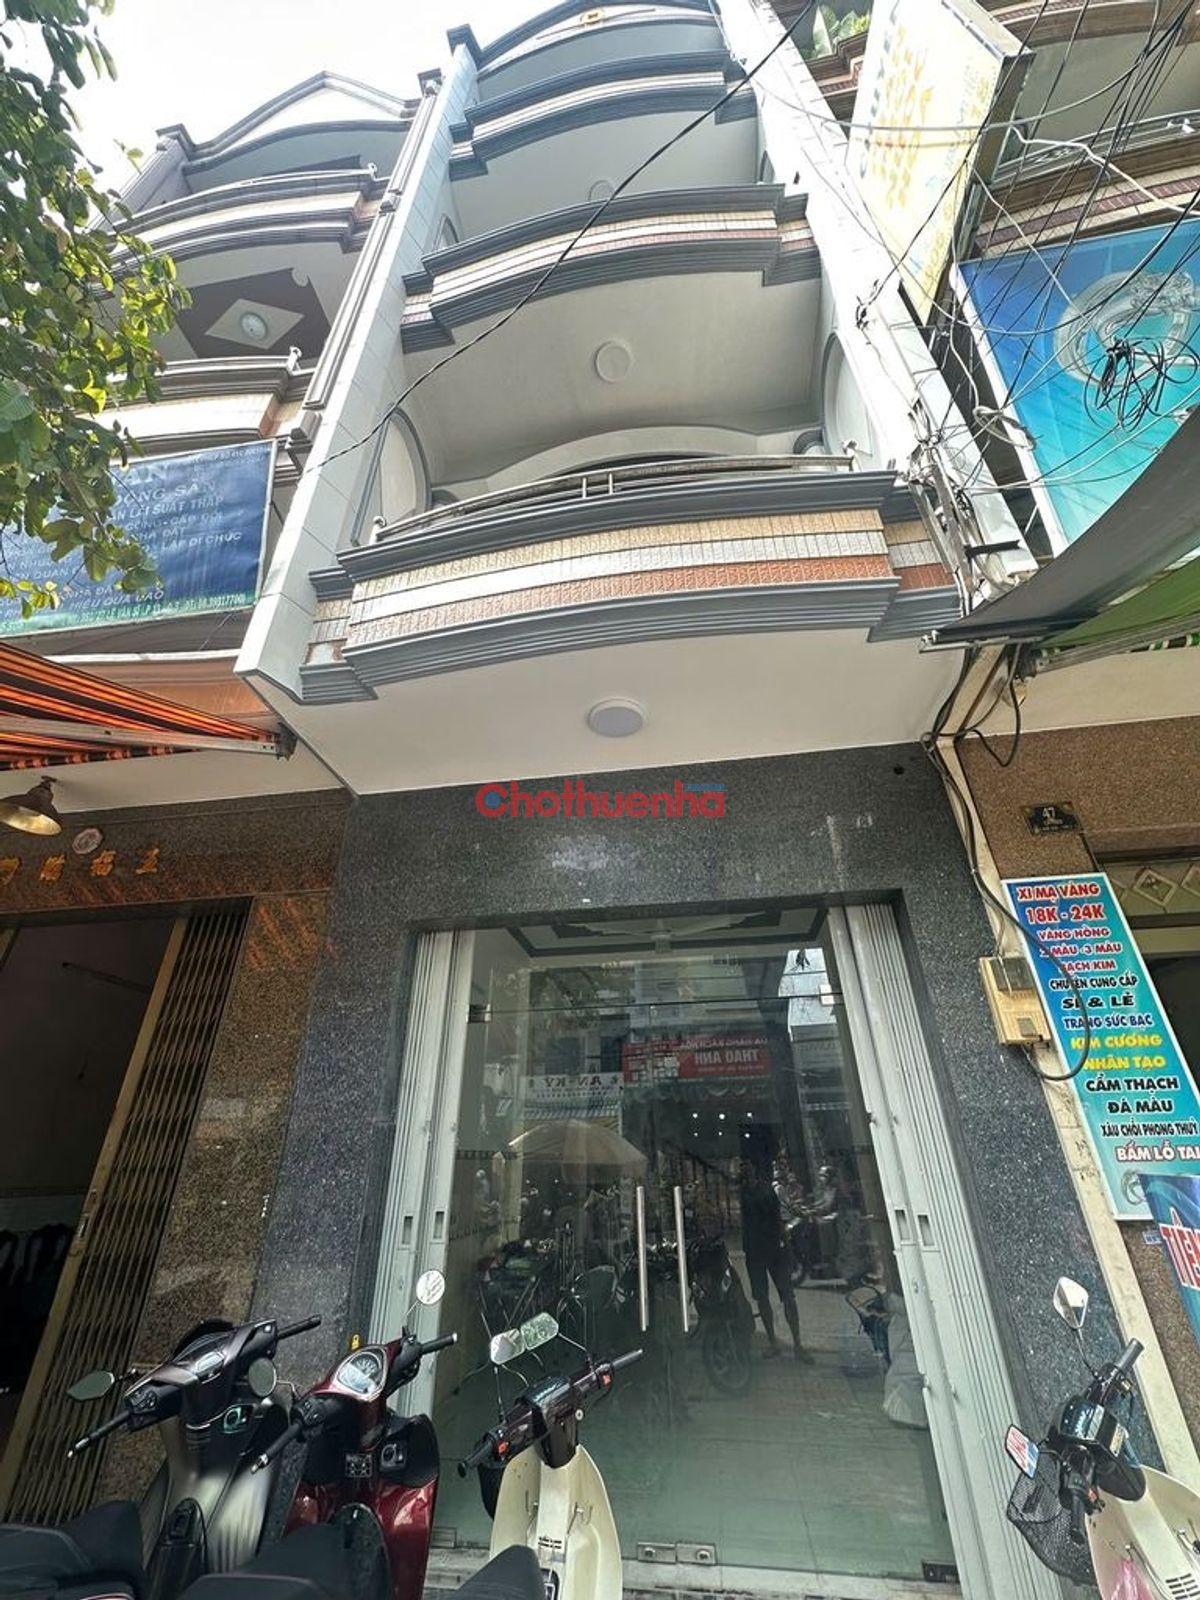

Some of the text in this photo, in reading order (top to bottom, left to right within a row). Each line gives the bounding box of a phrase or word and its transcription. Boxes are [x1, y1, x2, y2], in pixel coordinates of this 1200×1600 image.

[1018, 881, 1100, 902] XI MẠ VÀNG
[1026, 906, 1059, 923] 18K
[1071, 903, 1105, 920] 24K
[1038, 925, 1110, 940] VÀNG HỒNG
[1095, 940, 1122, 953] MÀU
[1093, 960, 1116, 970] KIM
[1090, 976, 1117, 989] CUNG
[1119, 970, 1138, 987] CẤP
[1087, 996, 1103, 1008] &
[1105, 1012, 1128, 1027] SỨC
[1130, 1013, 1153, 1031] BẠC
[1084, 1055, 1166, 1071] NHÂN TẠO
[1124, 1077, 1179, 1093] THẠCH
[1107, 1096, 1173, 1114] ĐÁ MÀU
[1143, 1122, 1175, 1136] PHONG
[1115, 1140, 1150, 1161] BẤM
[1153, 1139, 1175, 1160] LỖ
